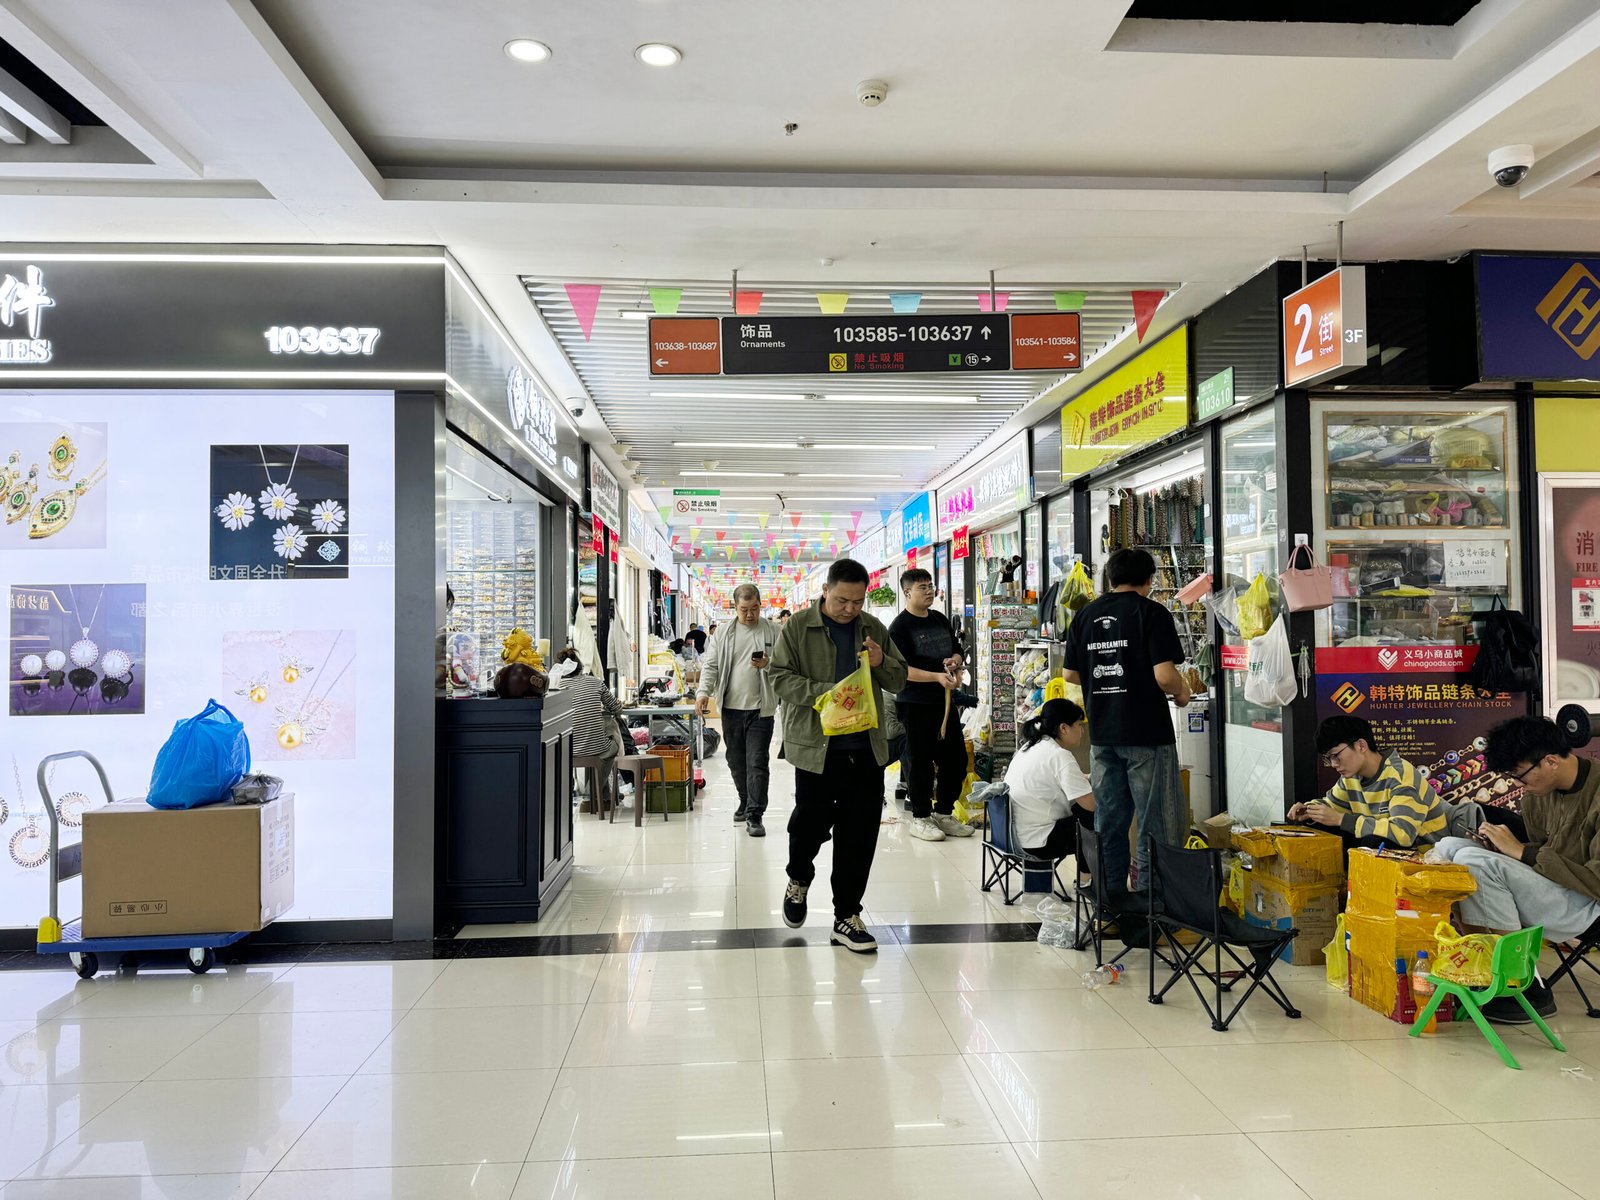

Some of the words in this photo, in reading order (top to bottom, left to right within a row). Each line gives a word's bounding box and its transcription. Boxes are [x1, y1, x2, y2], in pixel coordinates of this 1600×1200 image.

[740, 324, 772, 339] 饰品
[833, 325, 973, 343] 103585-103637
[1318, 311, 1334, 345] 街
[264, 326, 381, 355] 103637
[1293, 303, 1314, 367] 2
[1345, 329, 1363, 343] 3F
[654, 341, 717, 351] 103638-103687
[740, 340, 786, 349] Ornaments
[1015, 337, 1076, 346] 103541-103584
[1319, 345, 1334, 357] Street
[854, 352, 905, 364] 禁止吸烟
[967, 356, 977, 364] 15
[869, 362, 905, 370] Smoking
[1201, 387, 1231, 414] 103610
[1576, 530, 1595, 556] 消
[1576, 562, 1599, 573] FIRE
[1404, 649, 1463, 659] 义乌小商品城
[1404, 659, 1464, 669] chinagoods.com
[1369, 701, 1404, 710] HUNTER
[1406, 700, 1454, 710] JEWELLERY
[1456, 700, 1482, 708] CHAIN
[1485, 700, 1512, 708] STOCK
